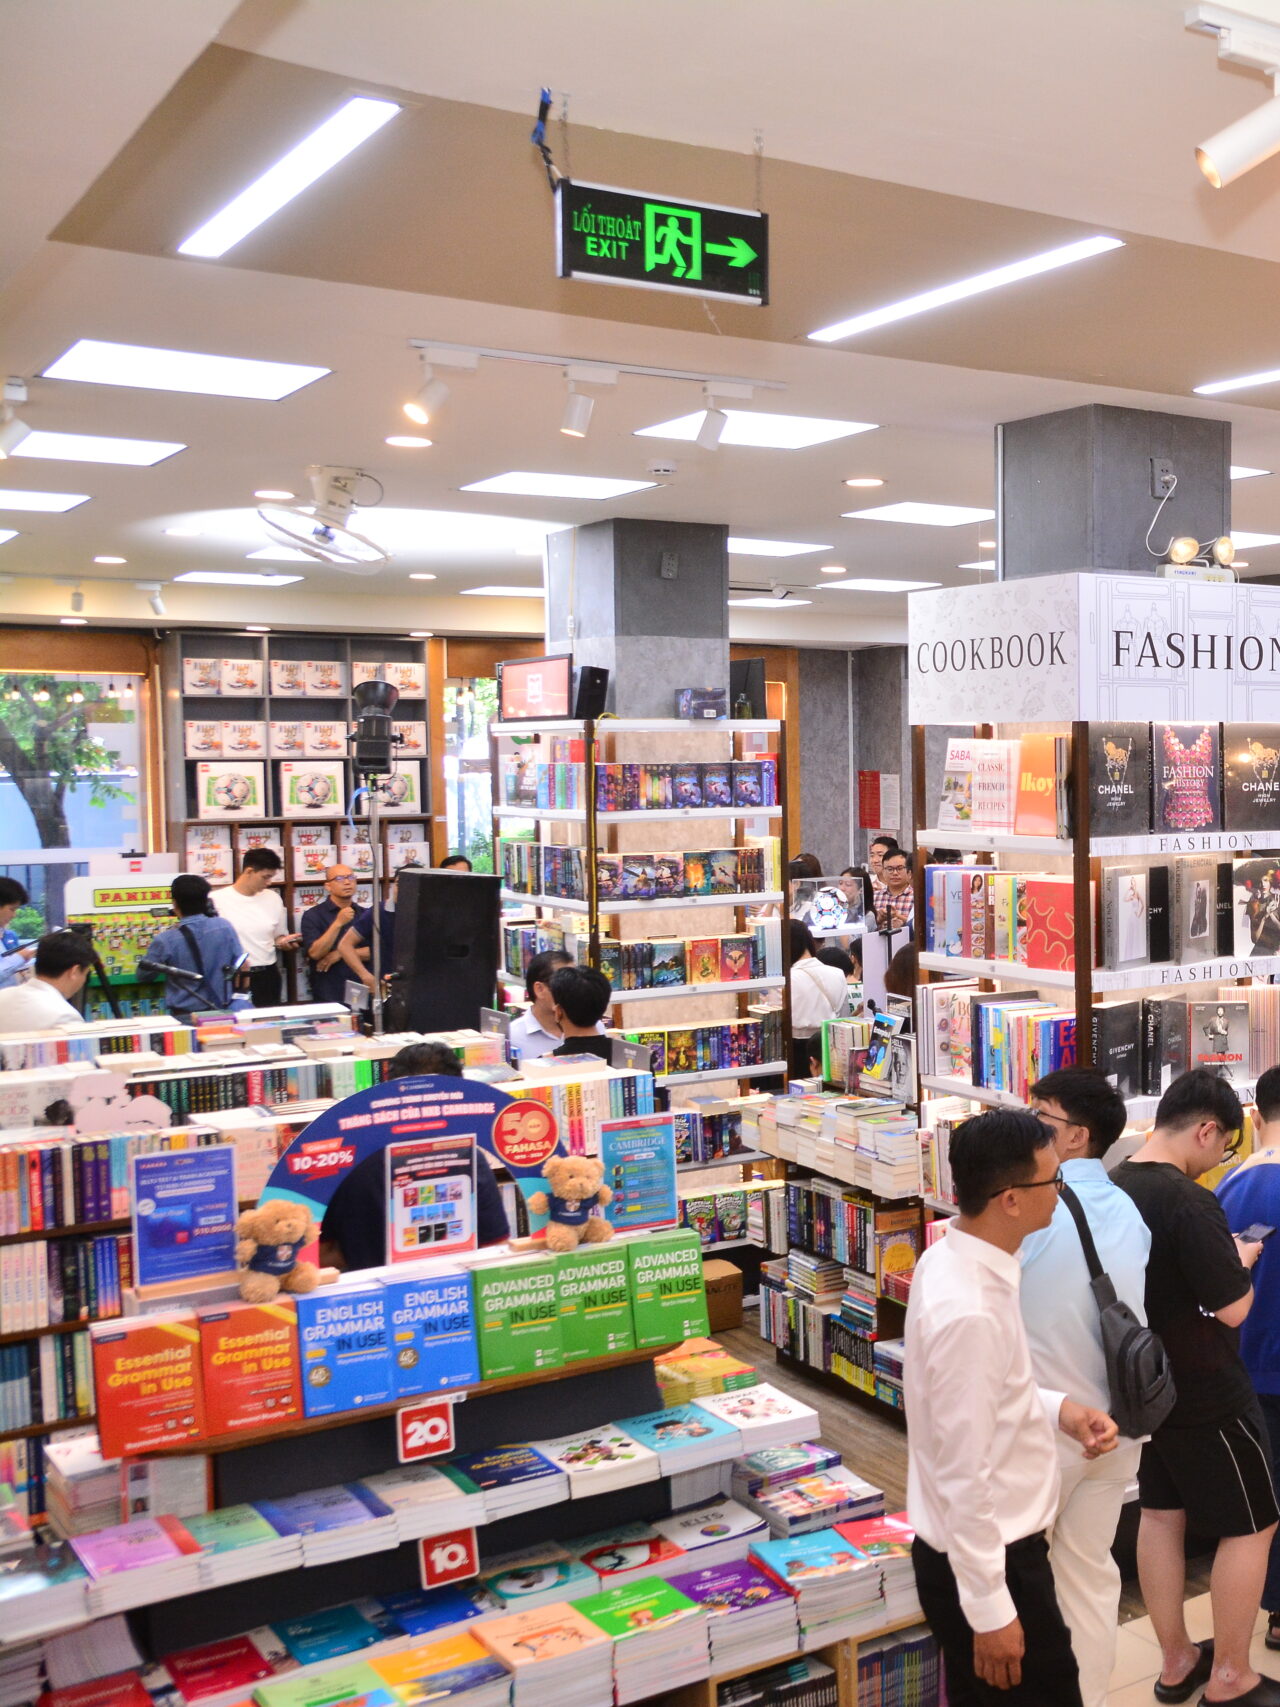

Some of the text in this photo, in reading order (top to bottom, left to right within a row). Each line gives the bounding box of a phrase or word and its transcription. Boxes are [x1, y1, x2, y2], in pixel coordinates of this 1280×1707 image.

[573, 203, 597, 233] LỐI
[585, 236, 629, 261] EXIT
[917, 631, 1068, 674] COOKBOOK
[978, 763, 1004, 771] CLASSIC
[1163, 766, 1214, 778] FASHION
[978, 782, 1005, 791] FRENCH
[1098, 784, 1134, 794] CHANEL
[1173, 779, 1205, 788] HISTORY
[978, 802, 1005, 810] RECIPES
[1160, 834, 1254, 852] FASHION
[1161, 962, 1255, 983] FASHION
[1109, 1043, 1135, 1055] GIVENCHY
[1197, 1053, 1243, 1061] FASHION
[442, 1102, 495, 1116] CAMBRIDGE
[502, 1110, 550, 1144] 50
[504, 1141, 551, 1155] FAHASA
[609, 1137, 667, 1150] CAMBRIDGE
[293, 1149, 354, 1171] 10-20%
[634, 1249, 698, 1270] ADVANCED
[558, 1260, 624, 1282] ADVANCED
[637, 1263, 699, 1284] GRAMMAR
[481, 1274, 554, 1297] ADVANCED
[560, 1275, 626, 1297] GRAMMAR
[659, 1282, 673, 1295] IN
[677, 1277, 701, 1292] USE
[404, 1285, 468, 1307] ENGLISH
[484, 1289, 556, 1312] GRAMMAR
[584, 1290, 627, 1308] IN USE
[316, 1301, 384, 1324] ENGLISH
[392, 1300, 469, 1324] GRAMMAR
[509, 1304, 557, 1323] IN USE
[303, 1316, 385, 1341] GRAMMAR
[424, 1315, 471, 1334] IN USE
[218, 1326, 291, 1351] Essential
[336, 1331, 386, 1351] IN USE
[115, 1344, 192, 1372] Essential
[211, 1342, 291, 1366] Grammar
[107, 1361, 192, 1388] Grammar
[242, 1356, 292, 1375] in Use
[140, 1376, 194, 1396] in Use
[680, 1512, 724, 1528] IELTS
